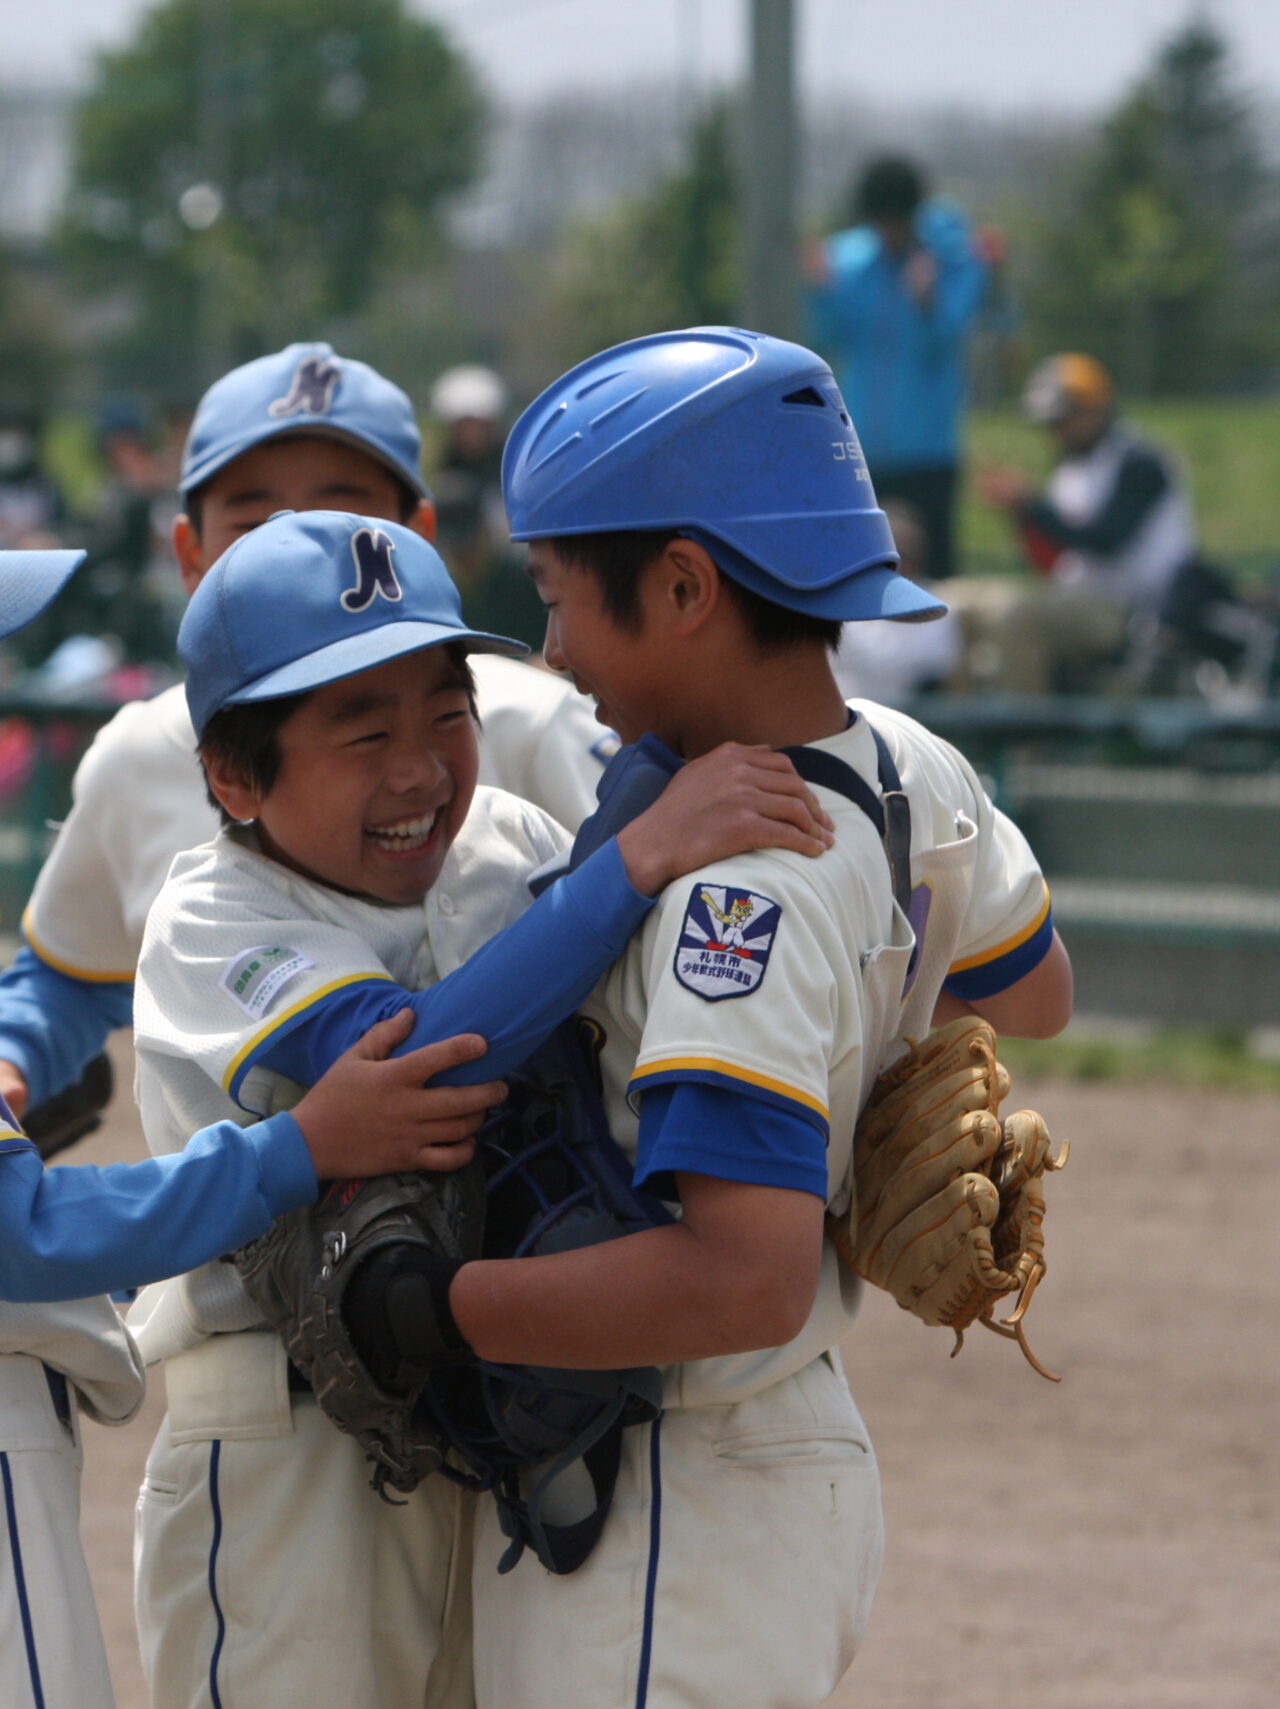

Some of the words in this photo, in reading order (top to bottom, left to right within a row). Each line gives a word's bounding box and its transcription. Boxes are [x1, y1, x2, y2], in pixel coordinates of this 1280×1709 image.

[831, 442, 865, 461] JS
[699, 950, 742, 968] 札幌市
